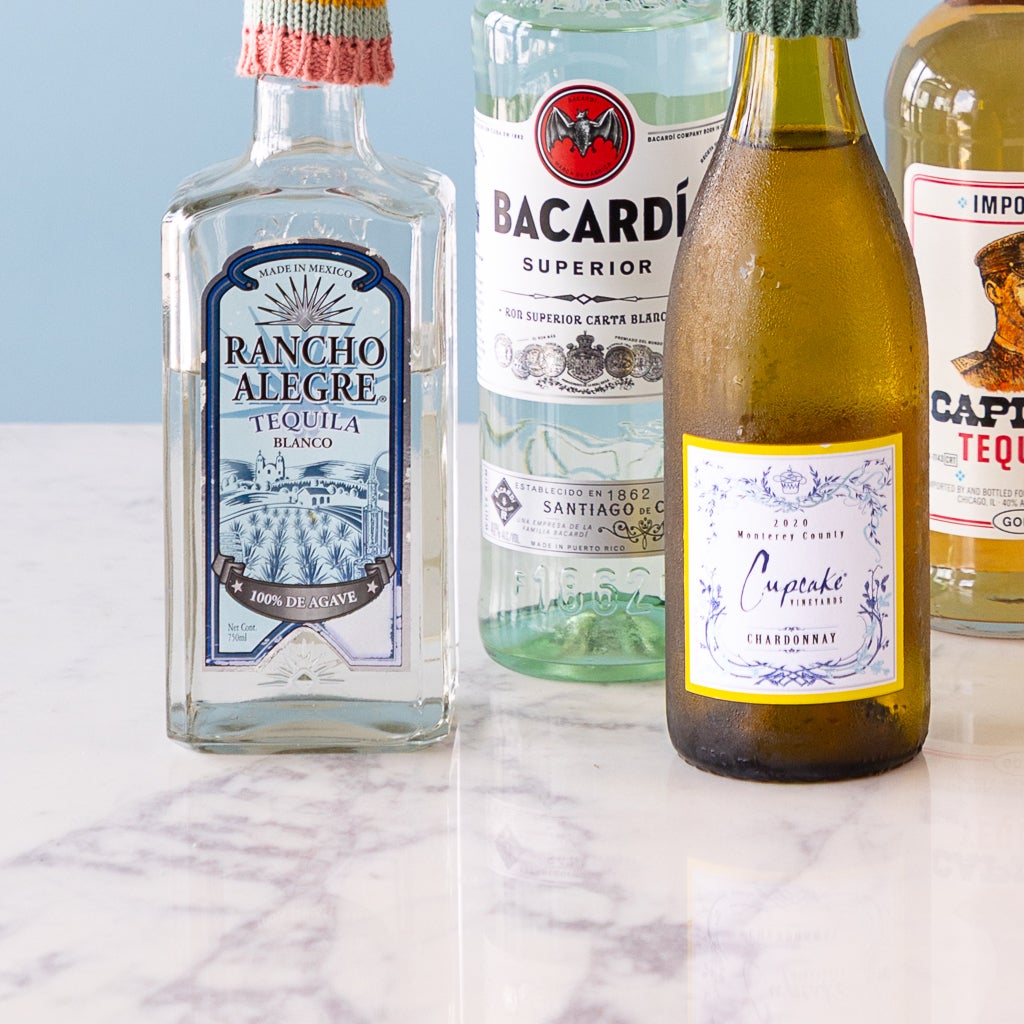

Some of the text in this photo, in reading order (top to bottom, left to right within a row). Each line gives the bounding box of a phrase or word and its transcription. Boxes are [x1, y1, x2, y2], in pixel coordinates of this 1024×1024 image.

[677, 130, 702, 140] COMPANY
[494, 176, 689, 243] BACARDÍ
[259, 264, 353, 279] MADE IN MEXICO
[523, 257, 652, 275] SUPERIOR
[505, 307, 523, 320] RON
[526, 312, 582, 325] SUPERIOR
[587, 314, 626, 326] CARTA
[224, 335, 386, 366] RANCHO
[232, 372, 377, 402] ALEGRE
[249, 411, 360, 434] TEQUILA
[274, 437, 333, 448] BLANCO
[515, 482, 650, 501] ESTABLECIDO EN 1862
[957, 485, 966, 494] BY
[967, 487, 980, 495] AND
[983, 488, 1012, 497] BOTTLED
[543, 501, 634, 516] SANTIAGO
[640, 507, 651, 515] DE
[1002, 499, 1018, 507] 40%
[774, 519, 808, 527] 2020
[738, 530, 844, 541] Monterey County
[531, 540, 551, 549] MADE
[555, 542, 563, 550] IN
[740, 549, 843, 612] Cupcake
[250, 590, 358, 609] 100% DE AGAVE
[790, 596, 843, 606] VINEYARDS
[228, 623, 257, 632] Net Cont.
[228, 632, 247, 642] 750ml
[747, 633, 836, 645] CHARDONNAY
